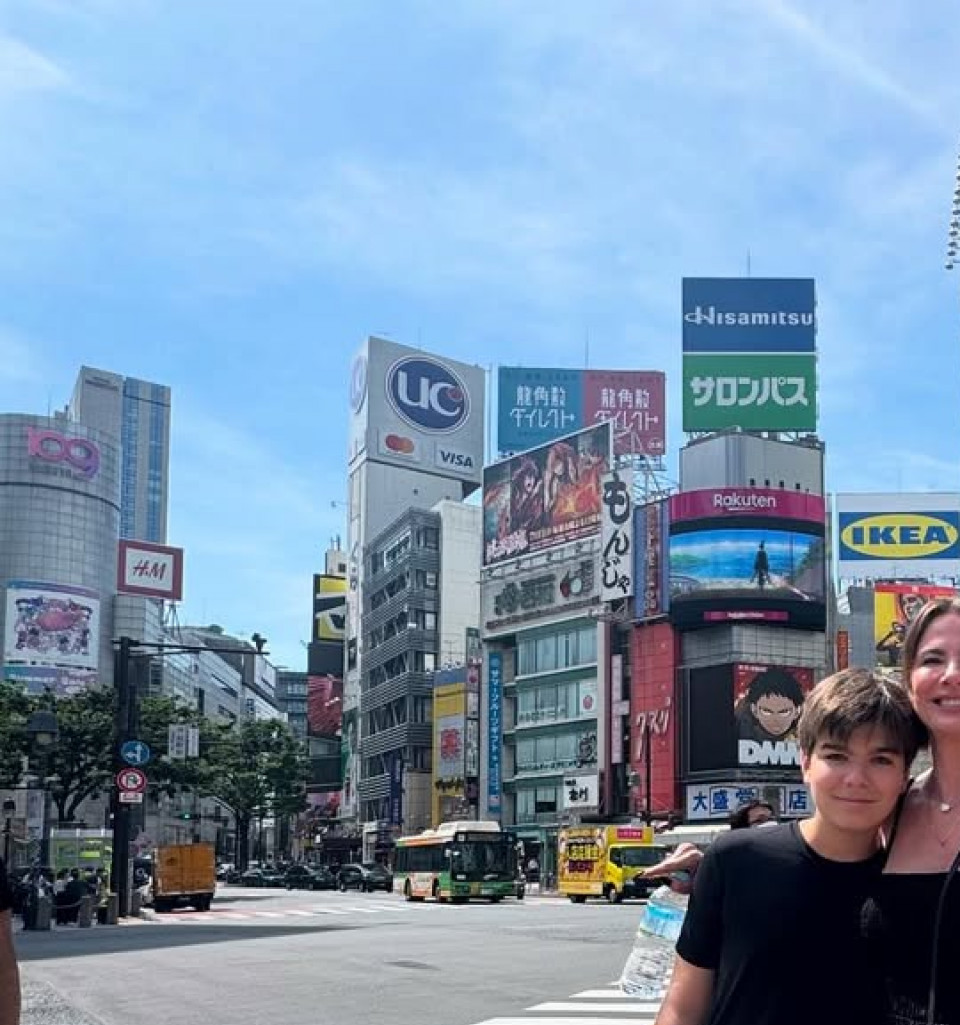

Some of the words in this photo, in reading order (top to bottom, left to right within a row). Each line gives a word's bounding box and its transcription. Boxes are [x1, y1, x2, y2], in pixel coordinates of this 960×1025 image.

[685, 306, 813, 326] Hisamitsu
[690, 377, 808, 406] サロンパス
[441, 450, 473, 467] VISA
[714, 492, 777, 508] Rakuten
[603, 469, 631, 594] もんじゃ
[852, 526, 949, 544] IKEA
[693, 786, 808, 811] 大盛堂店
